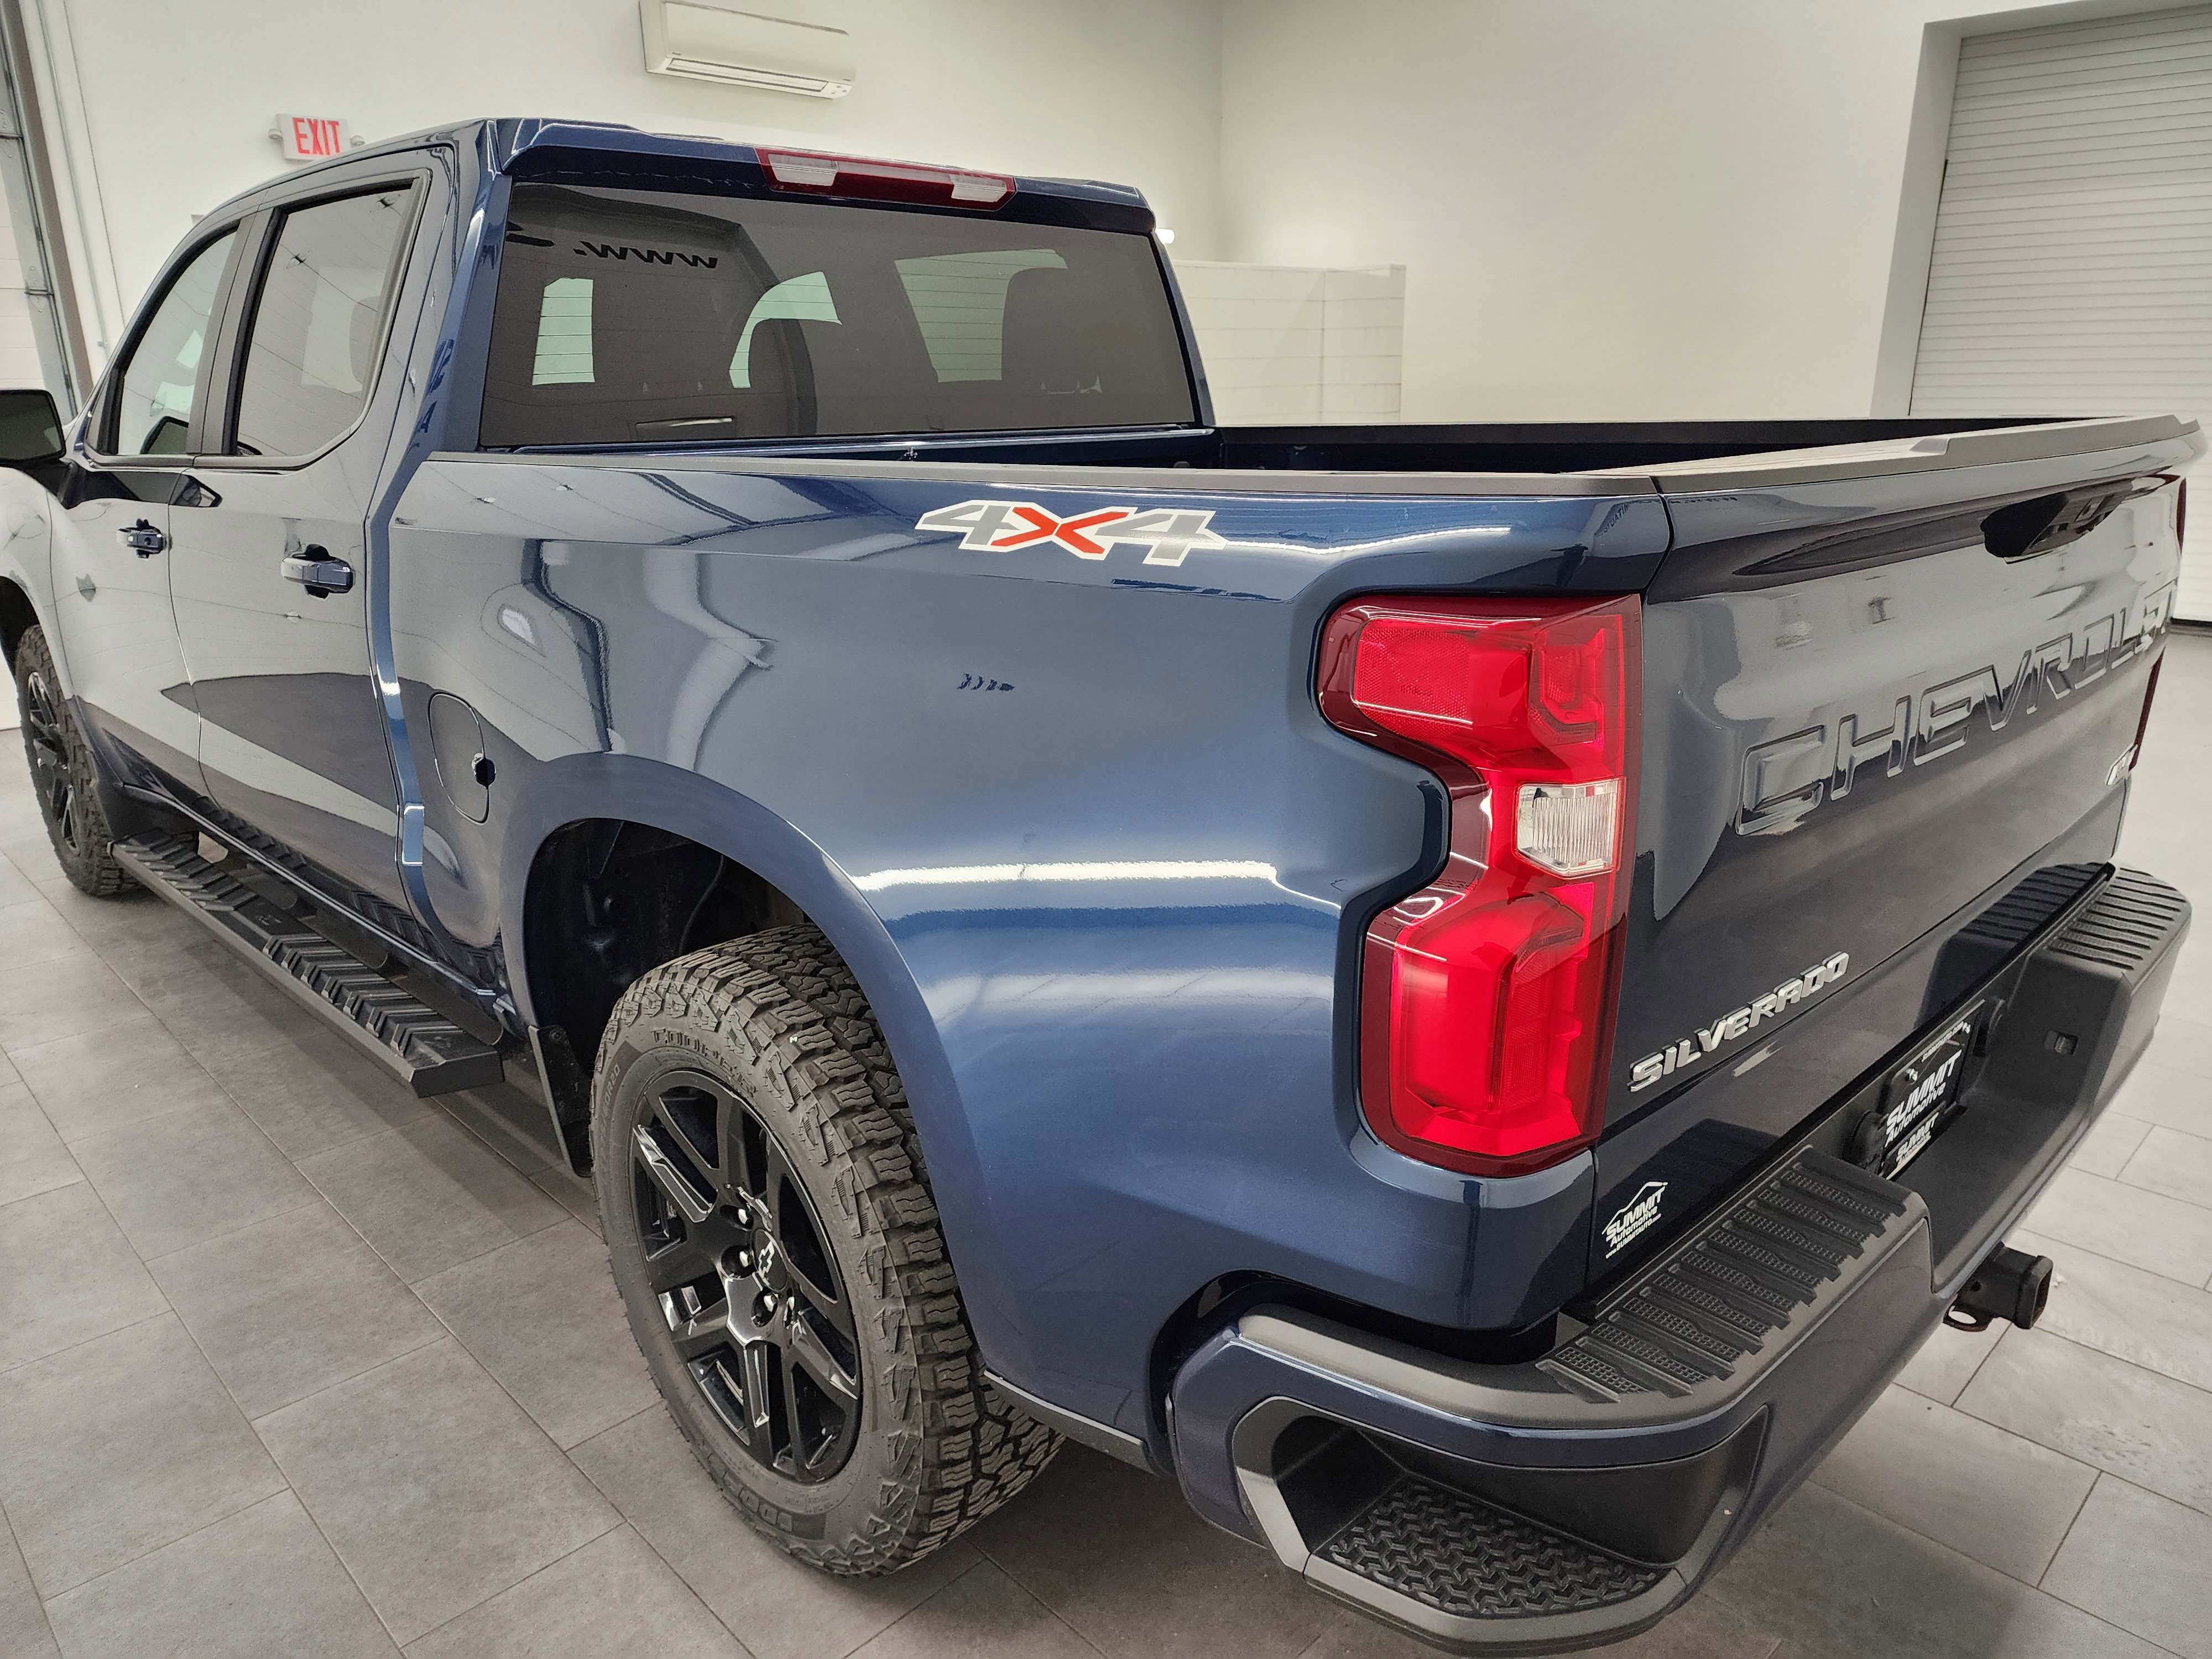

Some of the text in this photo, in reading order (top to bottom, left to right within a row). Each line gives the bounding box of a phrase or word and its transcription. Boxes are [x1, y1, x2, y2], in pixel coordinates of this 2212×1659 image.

[292, 117, 341, 155] EXIT
[1629, 951, 1849, 1092] SILVERADO
[1885, 1081, 1946, 1148] Automotive
[1886, 1049, 1962, 1135] SUMMIT
[1606, 1186, 1666, 1242] SUMMIT
[1610, 1206, 1658, 1248] Automotive
